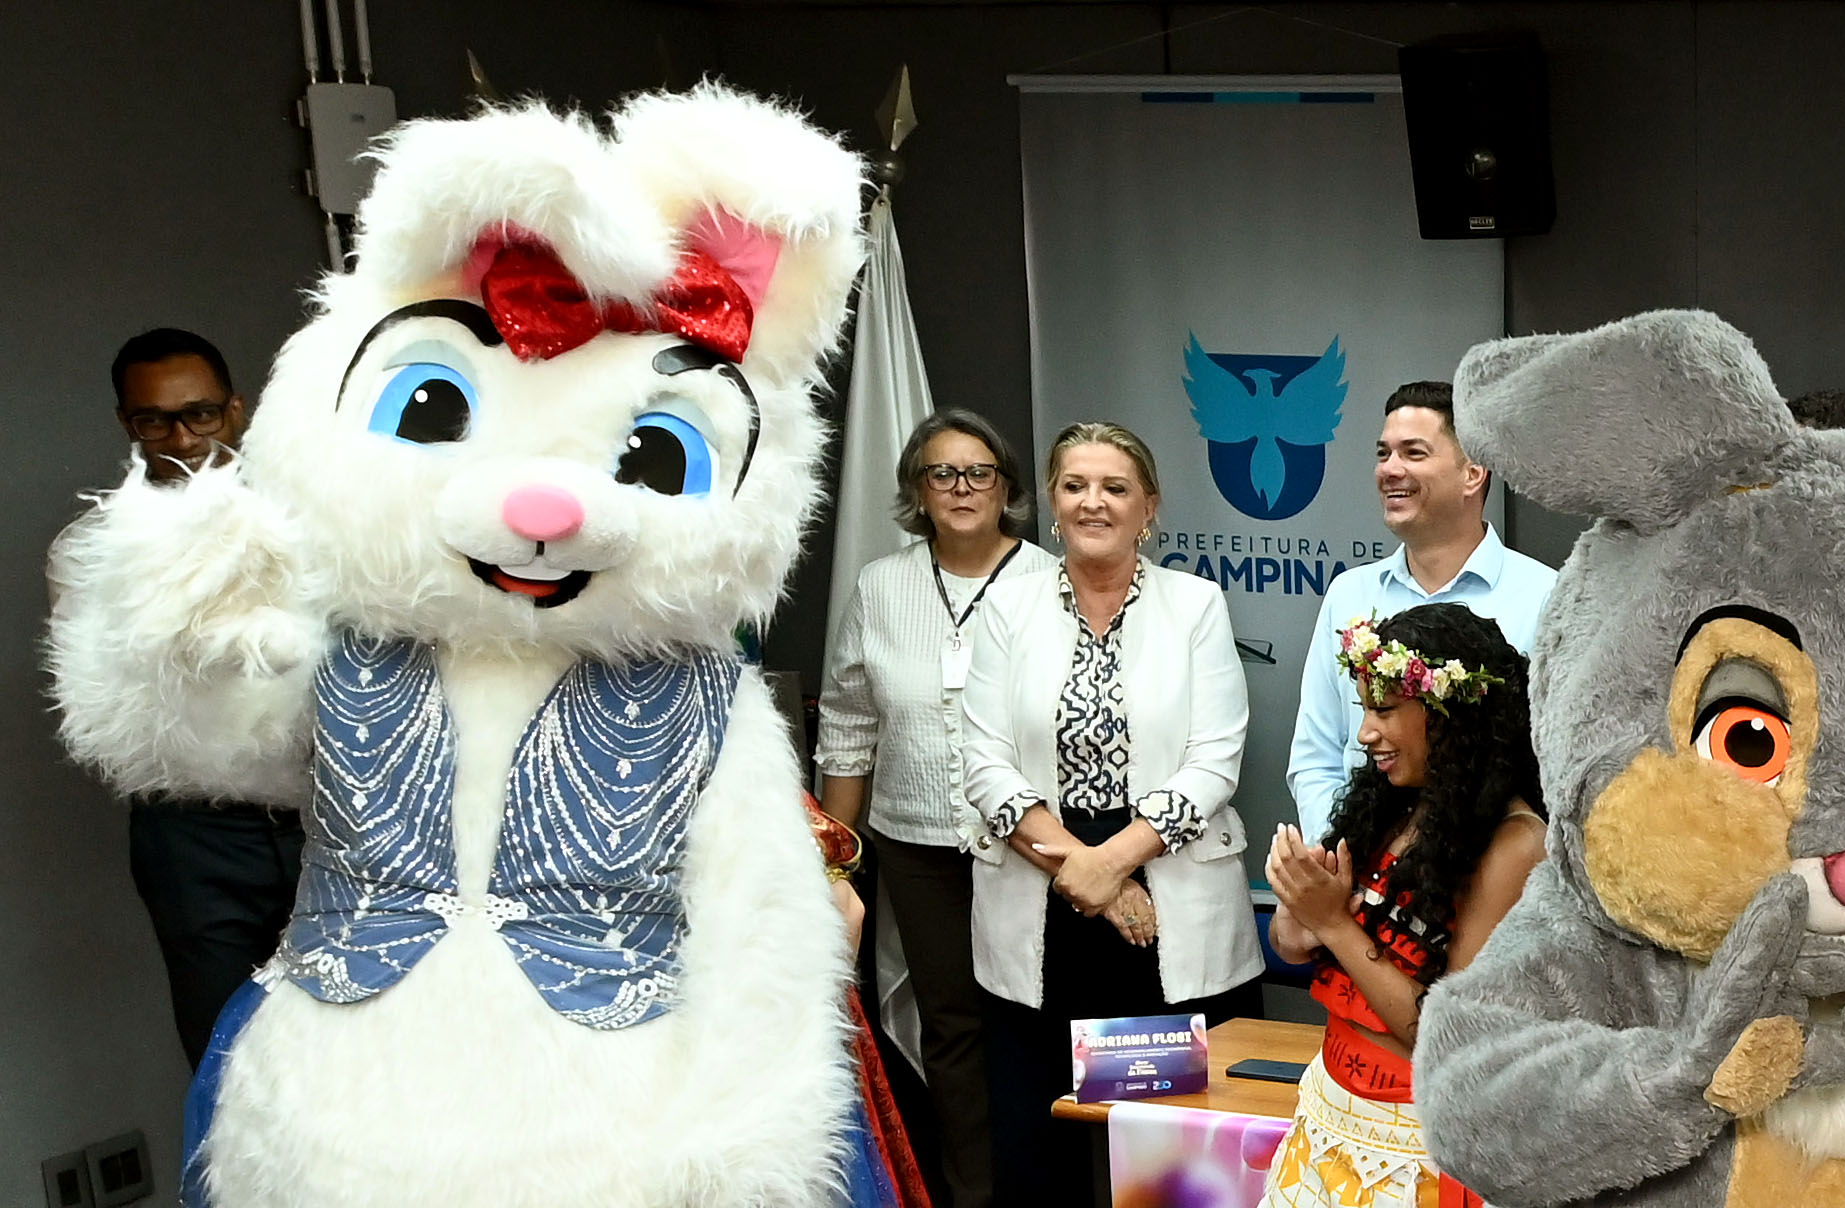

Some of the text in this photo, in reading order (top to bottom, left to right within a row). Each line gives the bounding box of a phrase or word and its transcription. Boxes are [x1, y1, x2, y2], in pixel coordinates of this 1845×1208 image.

[1158, 531, 1385, 559] PREFEITURA DE
[1087, 1033, 1150, 1048] ADRIANA
